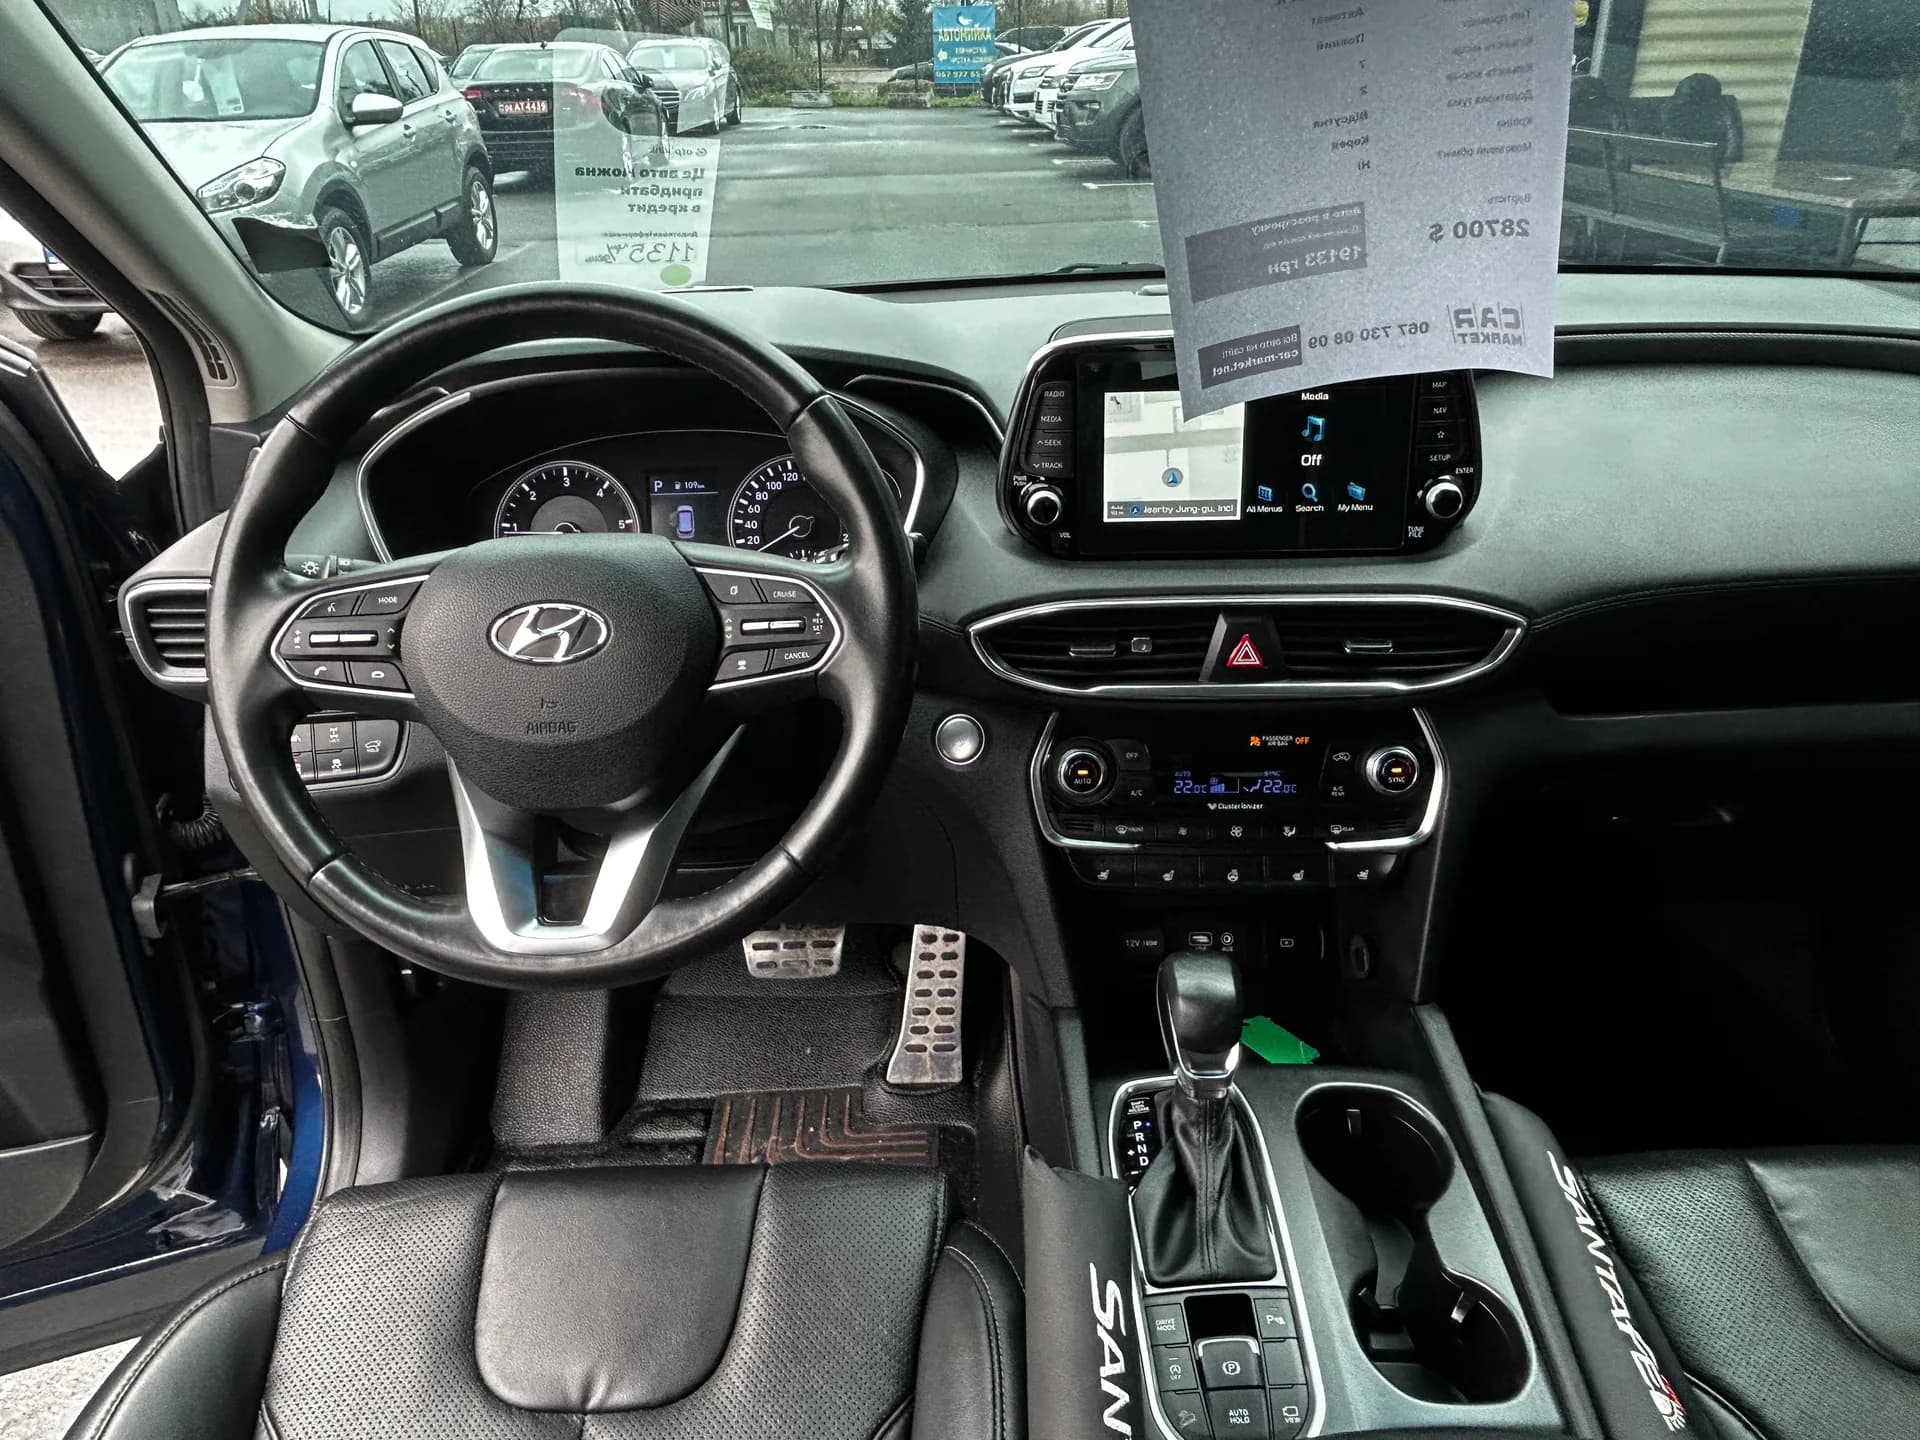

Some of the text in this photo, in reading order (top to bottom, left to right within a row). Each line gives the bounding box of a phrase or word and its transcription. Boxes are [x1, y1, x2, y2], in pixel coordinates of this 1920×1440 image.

[938, 24, 992, 41] АВТОМИЙКА
[1044, 390, 1065, 398] RADIO
[1301, 392, 1329, 401] Media
[1433, 407, 1448, 415] NAV
[1040, 415, 1063, 423] MEDIA
[1043, 439, 1062, 447] SEEK
[1301, 454, 1323, 467] Off
[1429, 454, 1452, 462] SETUP
[782, 472, 799, 481] 120
[563, 477, 571, 487] 3
[654, 480, 663, 493] P
[766, 481, 782, 490] 100
[529, 491, 537, 501] 2
[596, 488, 604, 498] 4
[755, 491, 769, 501] 80
[747, 504, 761, 514] 60
[1256, 505, 1283, 513] Menus
[1295, 504, 1325, 513] Search
[1337, 503, 1374, 512] My Menu
[618, 519, 626, 529] 5
[744, 520, 758, 529] 40
[747, 535, 760, 545] 20
[773, 590, 797, 598] CRUISE
[378, 596, 398, 604] MODE
[784, 651, 811, 660] CANCEL
[527, 721, 579, 736] AIRBAG
[1295, 736, 1310, 745] OFF
[1388, 776, 1406, 784] SYNC
[1130, 789, 1143, 797] A/C
[1133, 1120, 1142, 1130] P
[1135, 1132, 1145, 1142] R
[1136, 1143, 1148, 1154] N
[1138, 1156, 1149, 1166] D
[1156, 1324, 1176, 1332] MODE
[1228, 1408, 1249, 1417] AUTO
[1229, 1416, 1250, 1425] HOLD
[1284, 1416, 1301, 1424] VIEW
